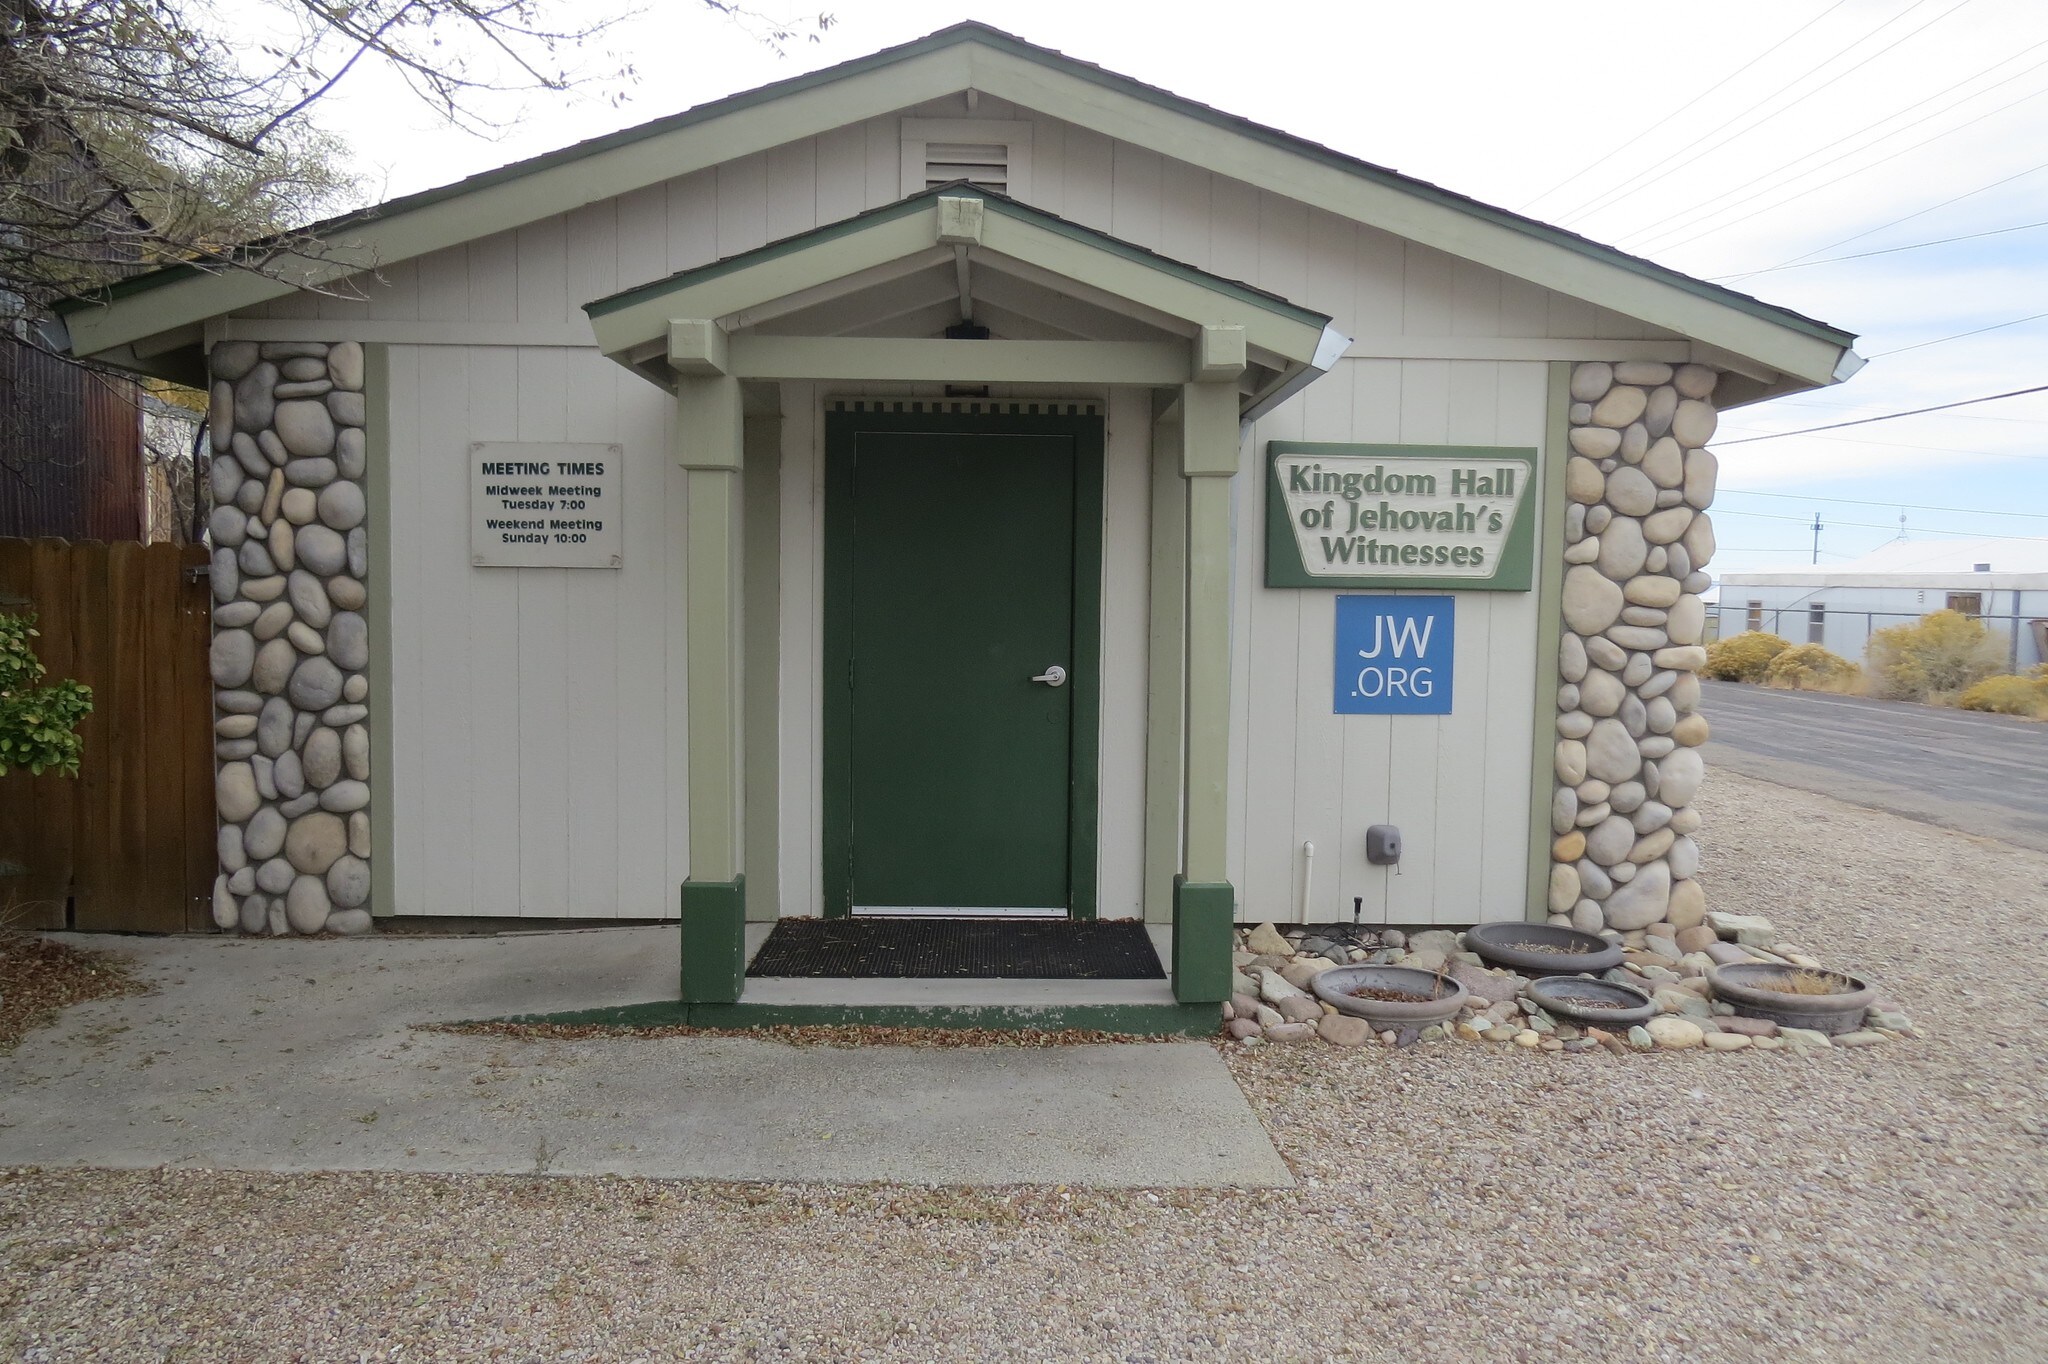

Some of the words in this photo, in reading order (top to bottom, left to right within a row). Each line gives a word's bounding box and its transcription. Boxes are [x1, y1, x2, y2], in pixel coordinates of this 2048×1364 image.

[482, 462, 550, 476] MEETING
[557, 462, 605, 476] TIMES
[486, 485, 543, 496] Midweek
[548, 485, 602, 497] Meeting
[1289, 463, 1437, 501] Kingdom
[1451, 468, 1516, 497] Hall
[502, 499, 555, 511] Tuesday
[560, 500, 586, 510] 7:00
[486, 519, 545, 530] Weekend
[550, 519, 603, 531] Meeting
[1300, 500, 1335, 530] of
[1346, 501, 1504, 534] Jehovah's
[502, 533, 549, 544] Sunday
[554, 533, 587, 543] 10:00
[1320, 535, 1485, 567] Witnesses
[1358, 615, 1435, 659] JW
[1351, 666, 1433, 698] .ORG
